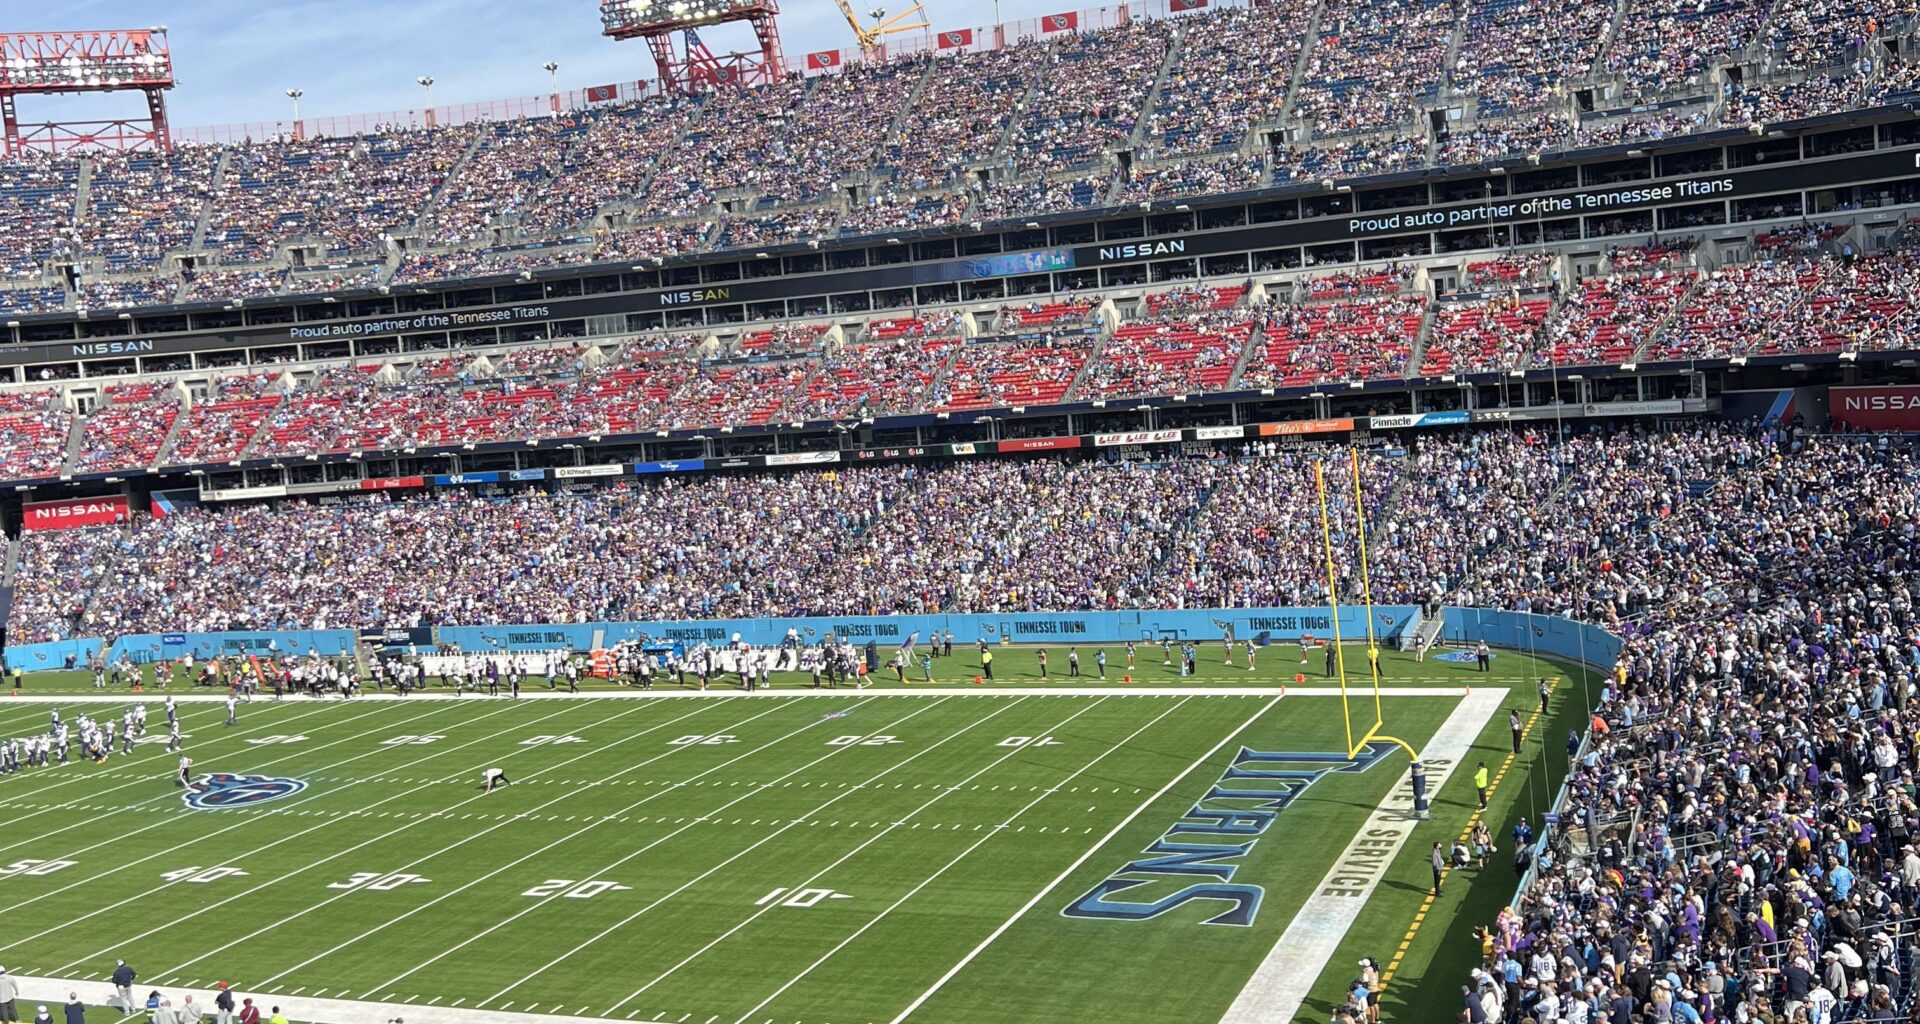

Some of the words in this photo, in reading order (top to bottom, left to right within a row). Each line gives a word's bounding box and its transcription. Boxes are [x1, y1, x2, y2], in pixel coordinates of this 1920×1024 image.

[1350, 215, 1400, 232] Proud
[1404, 211, 1445, 227] auto
[1450, 204, 1516, 225] partner
[1520, 199, 1539, 214] of
[1541, 197, 1572, 212] the
[1575, 186, 1673, 208] Tennessee
[1676, 178, 1734, 197] Titans
[1100, 239, 1185, 261] NISSAN
[660, 288, 730, 305] NISSAN
[290, 325, 329, 338] Proud
[332, 322, 362, 334] auto
[364, 318, 411, 335] partner
[413, 316, 426, 328] of
[427, 314, 449, 326] the
[451, 310, 511, 325] Tennessee
[512, 306, 549, 319] Titans
[73, 340, 153, 356] NISSAN
[1372, 416, 1412, 427] Pinnacle
[36, 502, 115, 518] NISSAN
[874, 623, 899, 636] TOUGH
[1015, 621, 1057, 634] TENNESSEE
[1250, 617, 1297, 630] TENNESSEE
[1300, 616, 1330, 629] TOUGH
[508, 632, 542, 644] TENNESSEE
[1059, 743, 1402, 927] TITANS
[0, 859, 79, 876] 50
[1321, 828, 1402, 898] SERVICE
[160, 866, 238, 883] 40
[326, 872, 420, 890] 30
[521, 879, 620, 899] 20
[754, 887, 837, 908] 10
[1819, 999, 1830, 1014] 18
